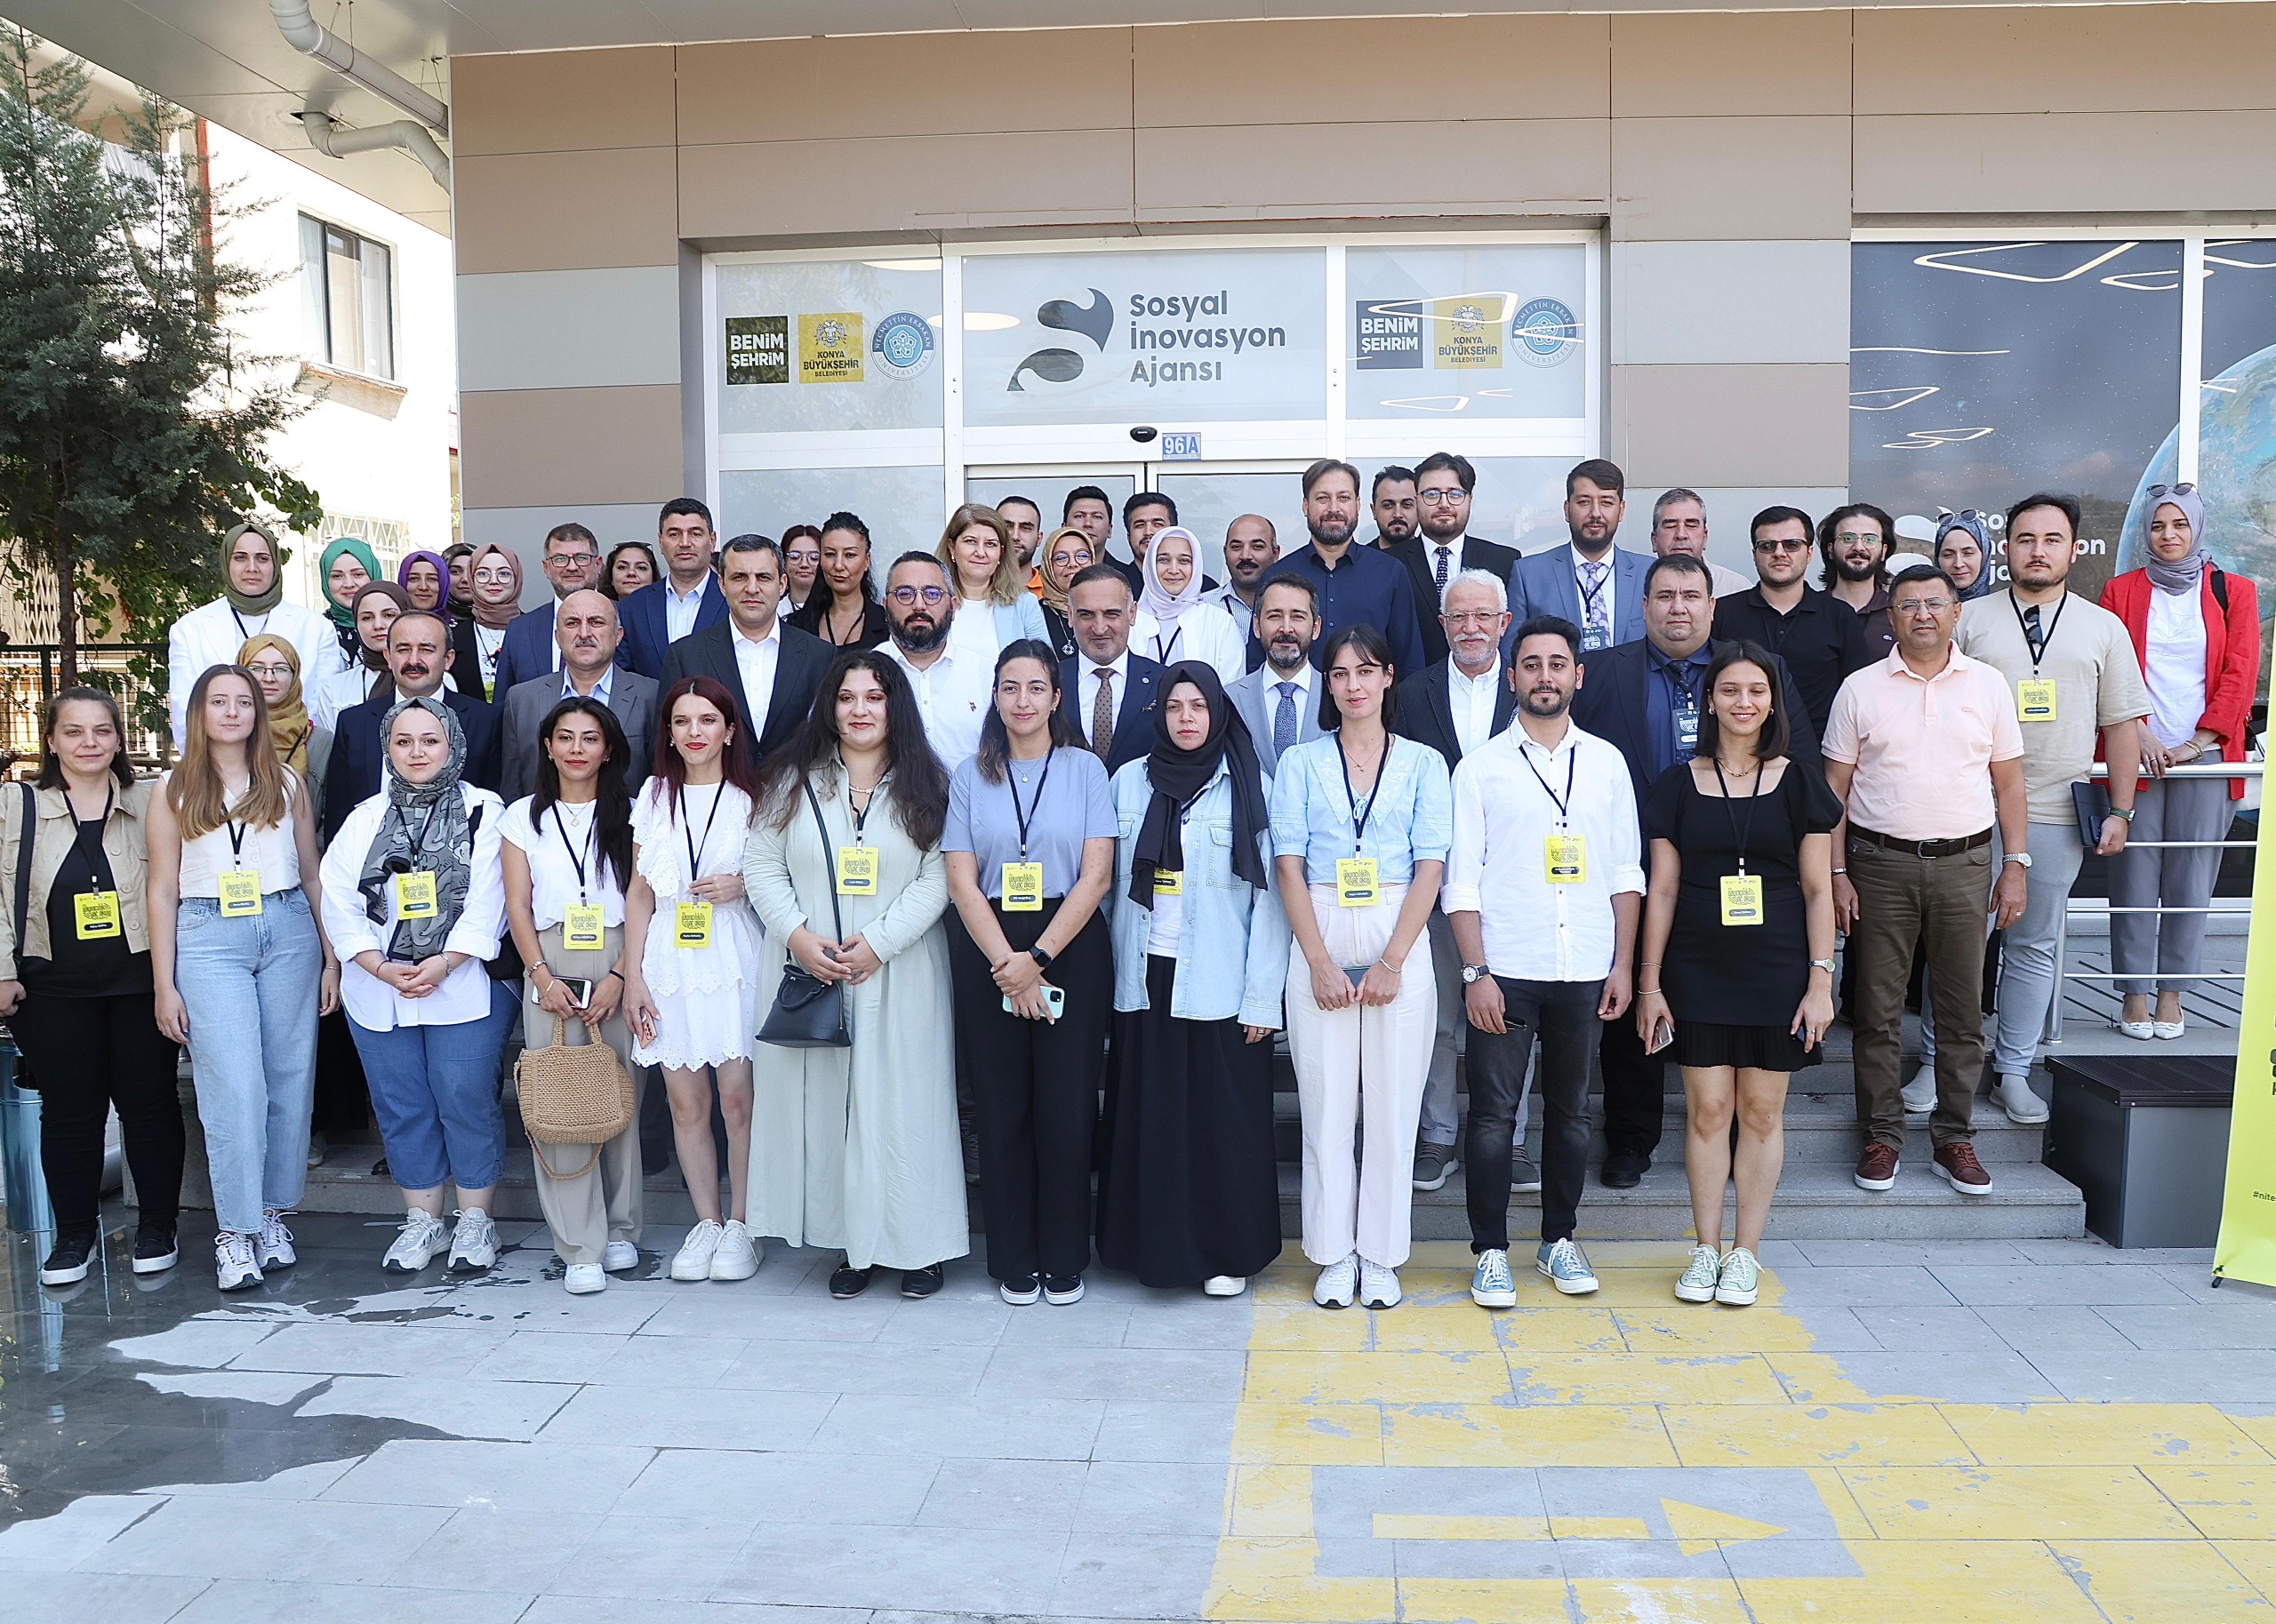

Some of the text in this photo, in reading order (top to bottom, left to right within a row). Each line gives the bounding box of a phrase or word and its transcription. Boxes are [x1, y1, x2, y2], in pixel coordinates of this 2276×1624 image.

[1129, 290, 1228, 323] Sosyal
[1453, 336, 1483, 345] KONYA
[817, 350, 845, 359] KONYA
[1129, 355, 1222, 388] Ajansı
